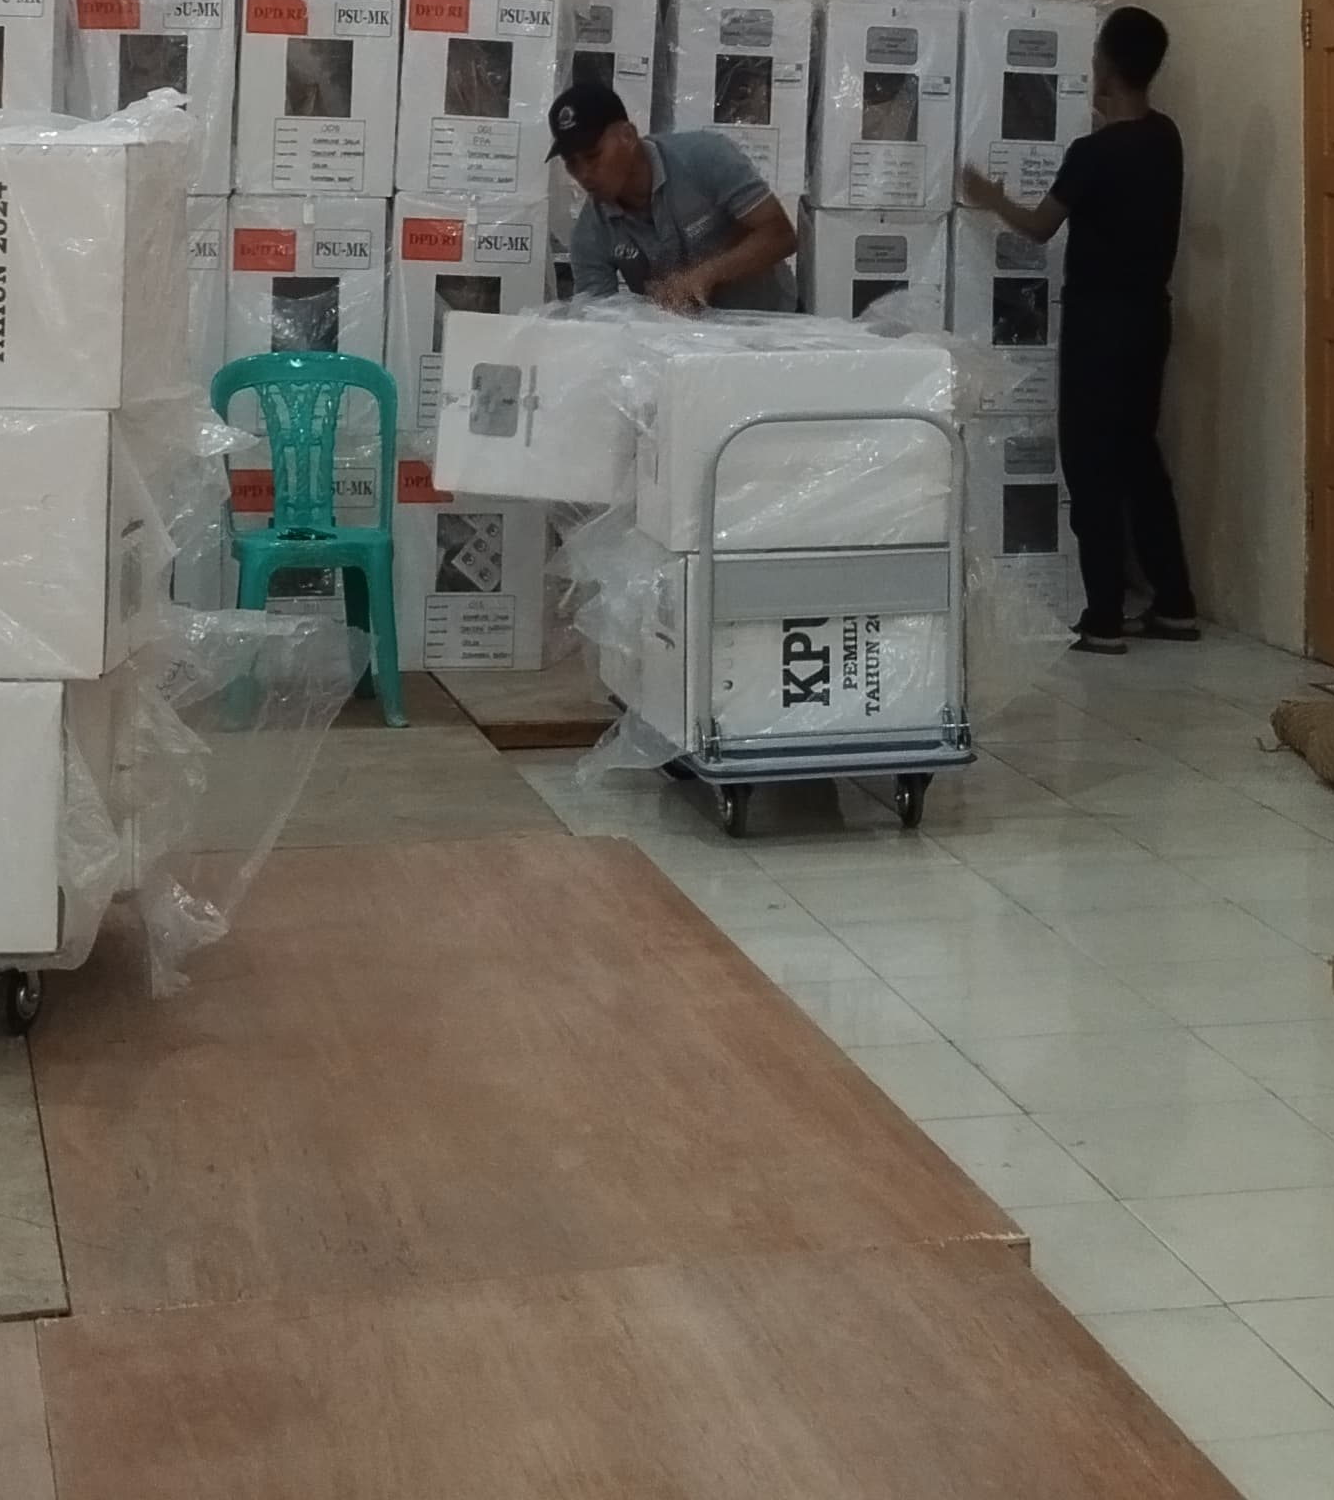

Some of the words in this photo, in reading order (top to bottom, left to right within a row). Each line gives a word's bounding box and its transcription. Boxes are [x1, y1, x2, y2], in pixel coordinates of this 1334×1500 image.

[166, 2, 220, 19] SU-MK
[254, 7, 282, 20] DPD
[287, 8, 305, 20] RI
[337, 9, 390, 26] PSU-MK
[415, 3, 444, 17] DPD
[447, 3, 463, 17] RI
[500, 8, 551, 26] PSU-MK
[409, 233, 439, 246] DPD
[441, 233, 458, 246] RI
[476, 235, 530, 252] PSU-MK
[315, 241, 369, 258] PSU-MK
[865, 640, 880, 717] TAHUN
